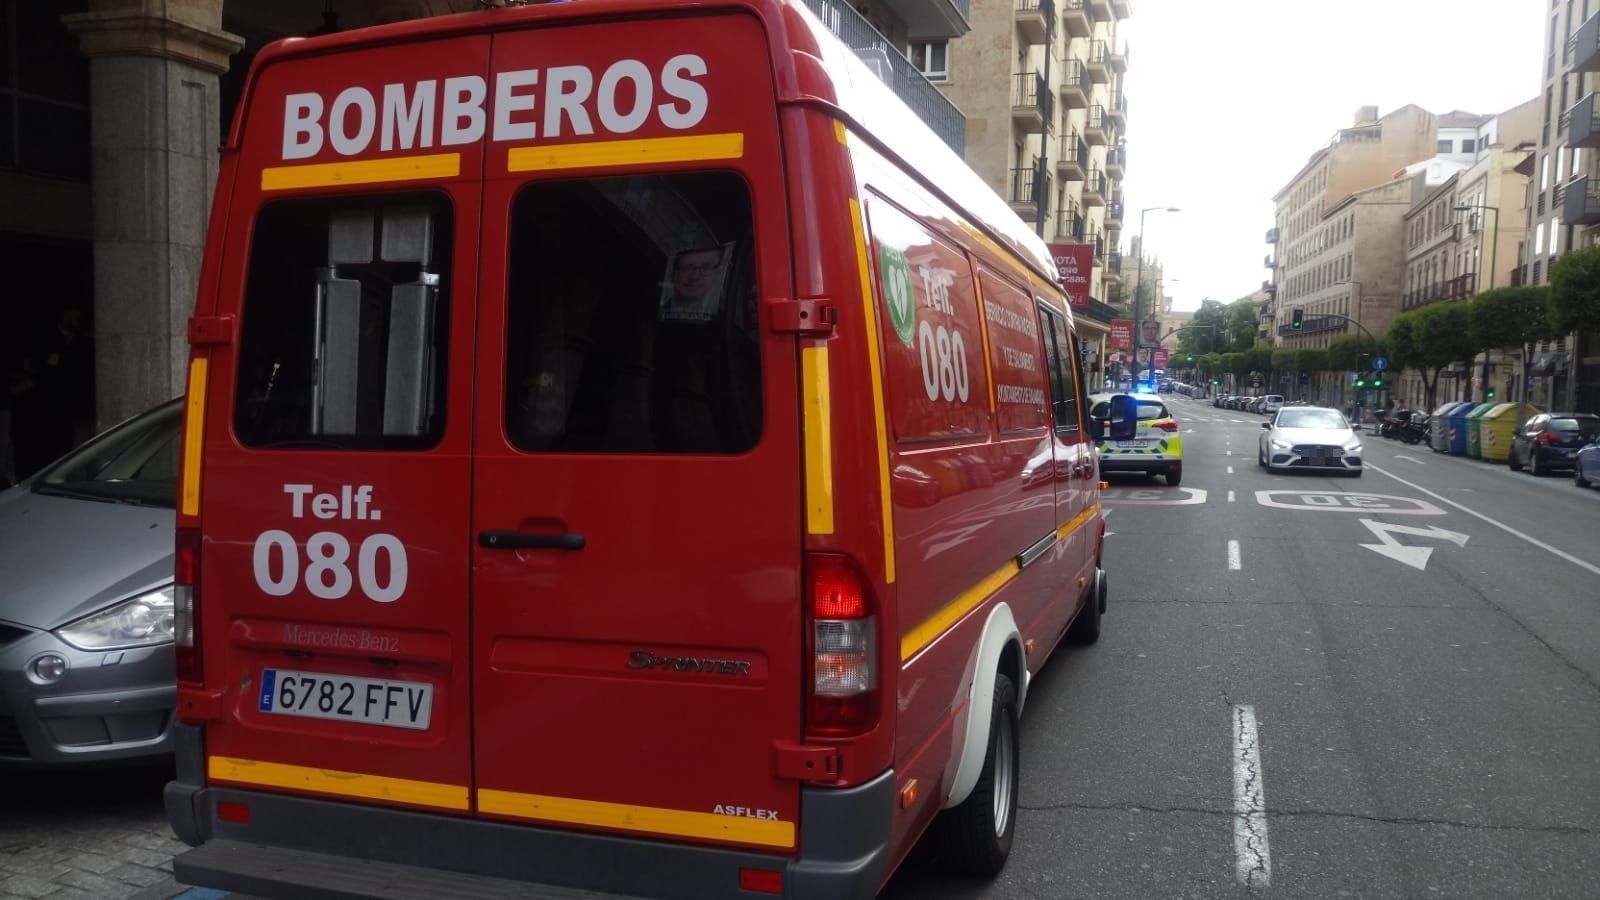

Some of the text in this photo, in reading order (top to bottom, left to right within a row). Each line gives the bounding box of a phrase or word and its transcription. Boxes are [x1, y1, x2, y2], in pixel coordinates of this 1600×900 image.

[282, 54, 708, 160] BOMBEROS
[918, 320, 969, 403] 080
[284, 484, 381, 521] Telf.
[253, 530, 408, 603] 080
[283, 624, 400, 652] Mercedes-Benz
[279, 676, 355, 716] 6782
[364, 684, 424, 723] FFV
[713, 804, 779, 821] ASFLEX
